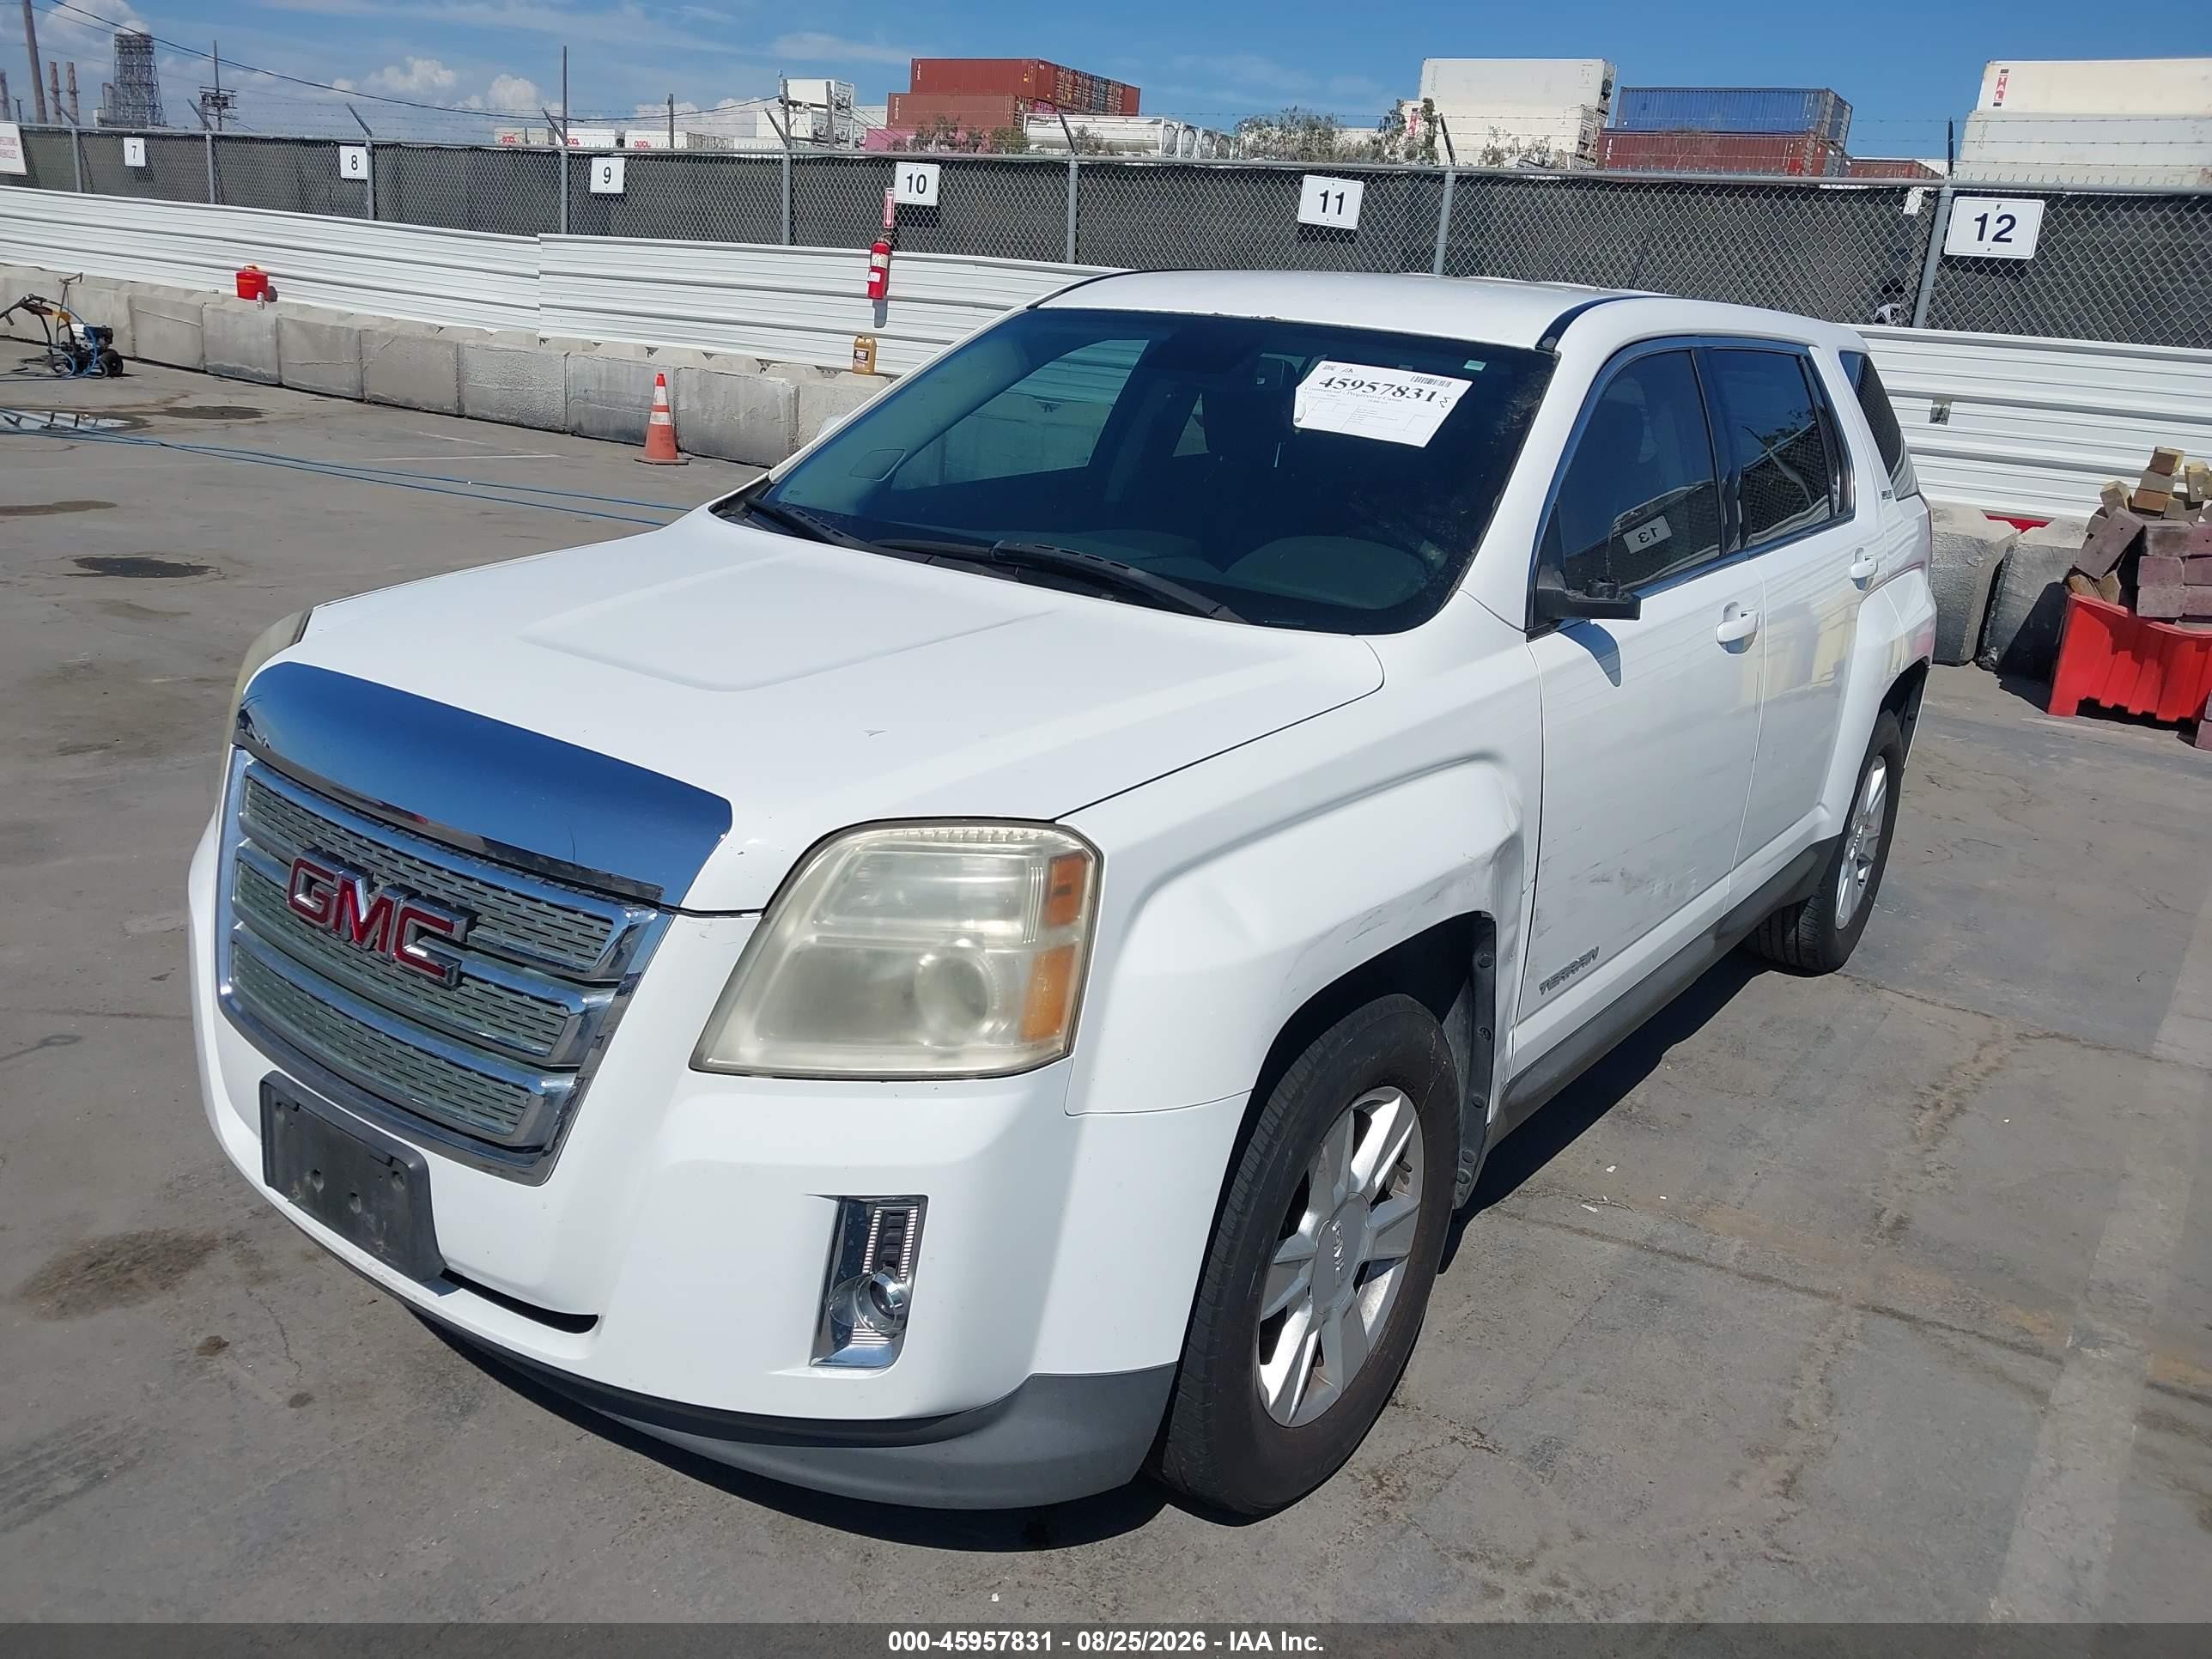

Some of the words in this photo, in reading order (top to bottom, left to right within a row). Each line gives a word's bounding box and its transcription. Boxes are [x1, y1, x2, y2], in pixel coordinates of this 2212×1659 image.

[1994, 76, 2008, 101] TAL
[131, 145, 137, 159] 7
[350, 155, 358, 170] 8
[603, 166, 611, 184] 9
[906, 173, 927, 195] 10
[1319, 190, 1345, 216] 11
[1974, 212, 2016, 243] 12
[1319, 376, 1437, 402] 45957831
[288, 857, 462, 983] GMC
[1539, 945, 1599, 996] TERRAIN
